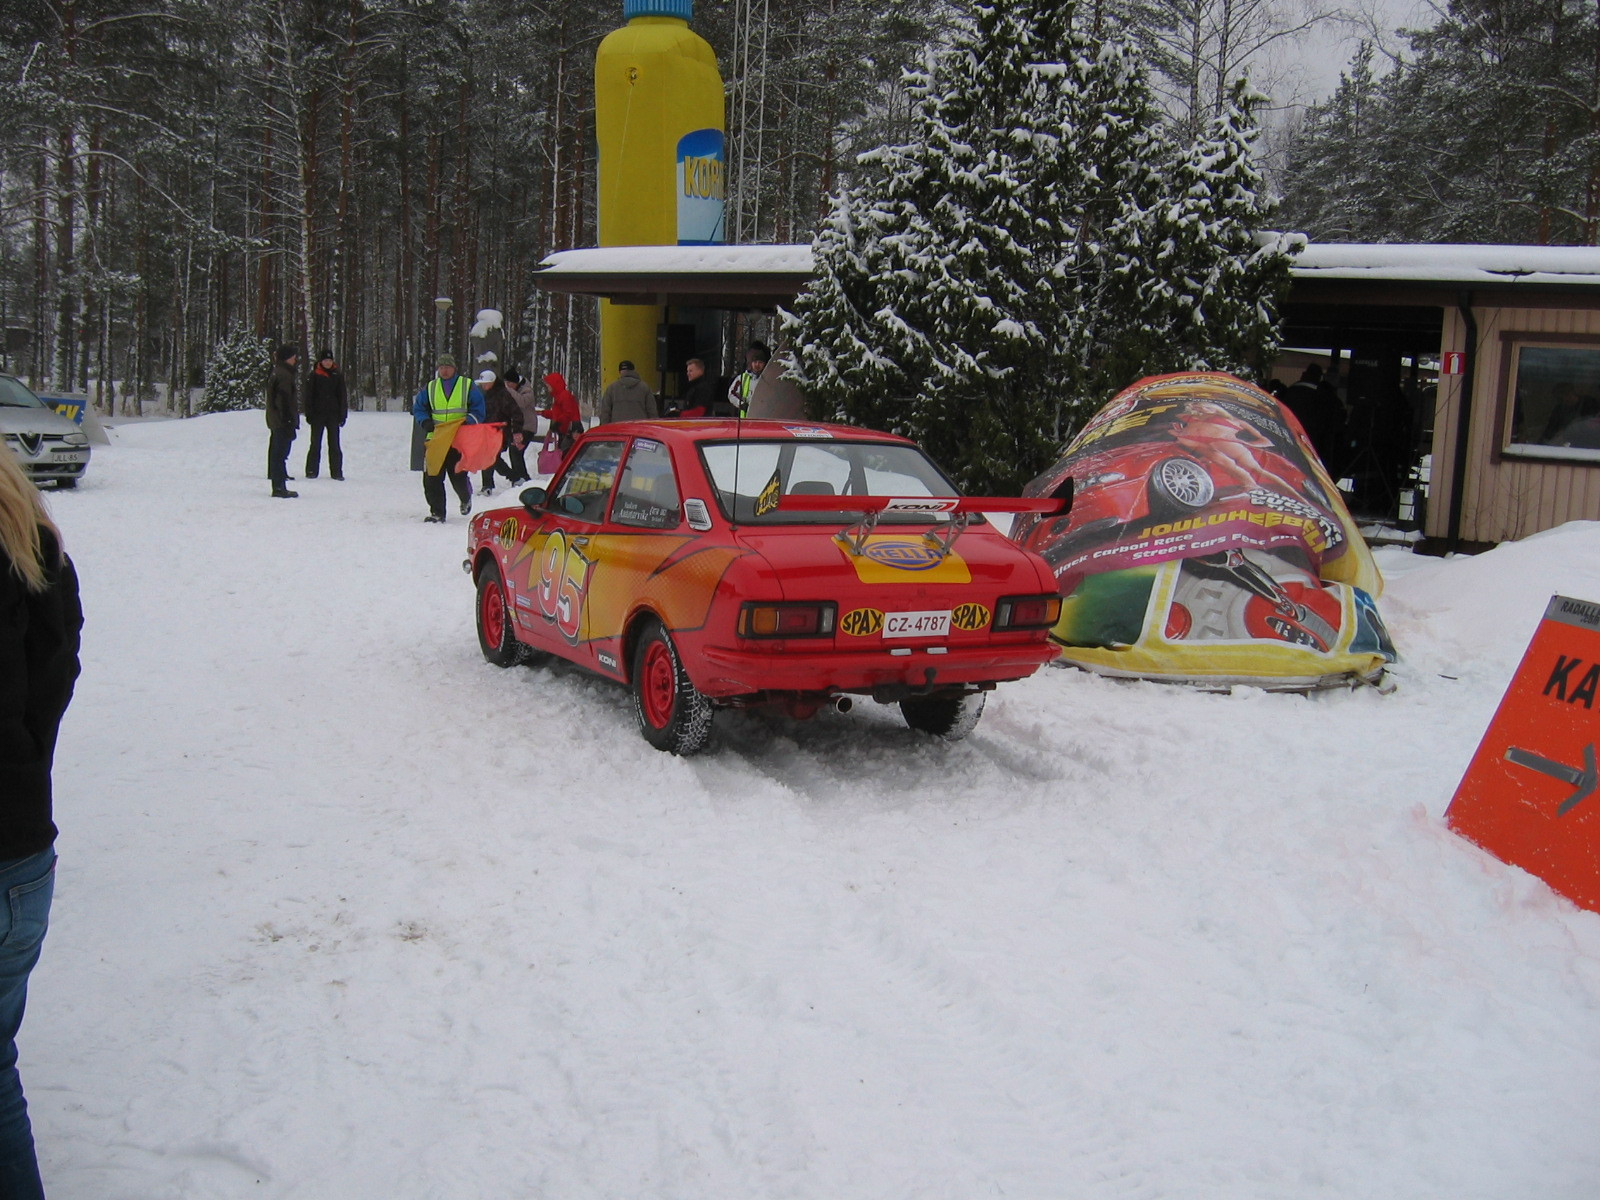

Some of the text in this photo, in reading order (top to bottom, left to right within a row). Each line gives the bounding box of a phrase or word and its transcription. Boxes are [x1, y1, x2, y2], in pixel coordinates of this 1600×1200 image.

[868, 548, 943, 560] HELLA
[1092, 541, 1150, 559] Carbon
[1154, 533, 1194, 547] Race
[1132, 543, 1186, 560] Street
[1190, 536, 1226, 551] Cars
[537, 527, 590, 647] 95
[843, 609, 882, 635] SPAX
[888, 616, 947, 633] CZ-4787
[952, 604, 989, 629] SPAX
[598, 653, 617, 668] KONI
